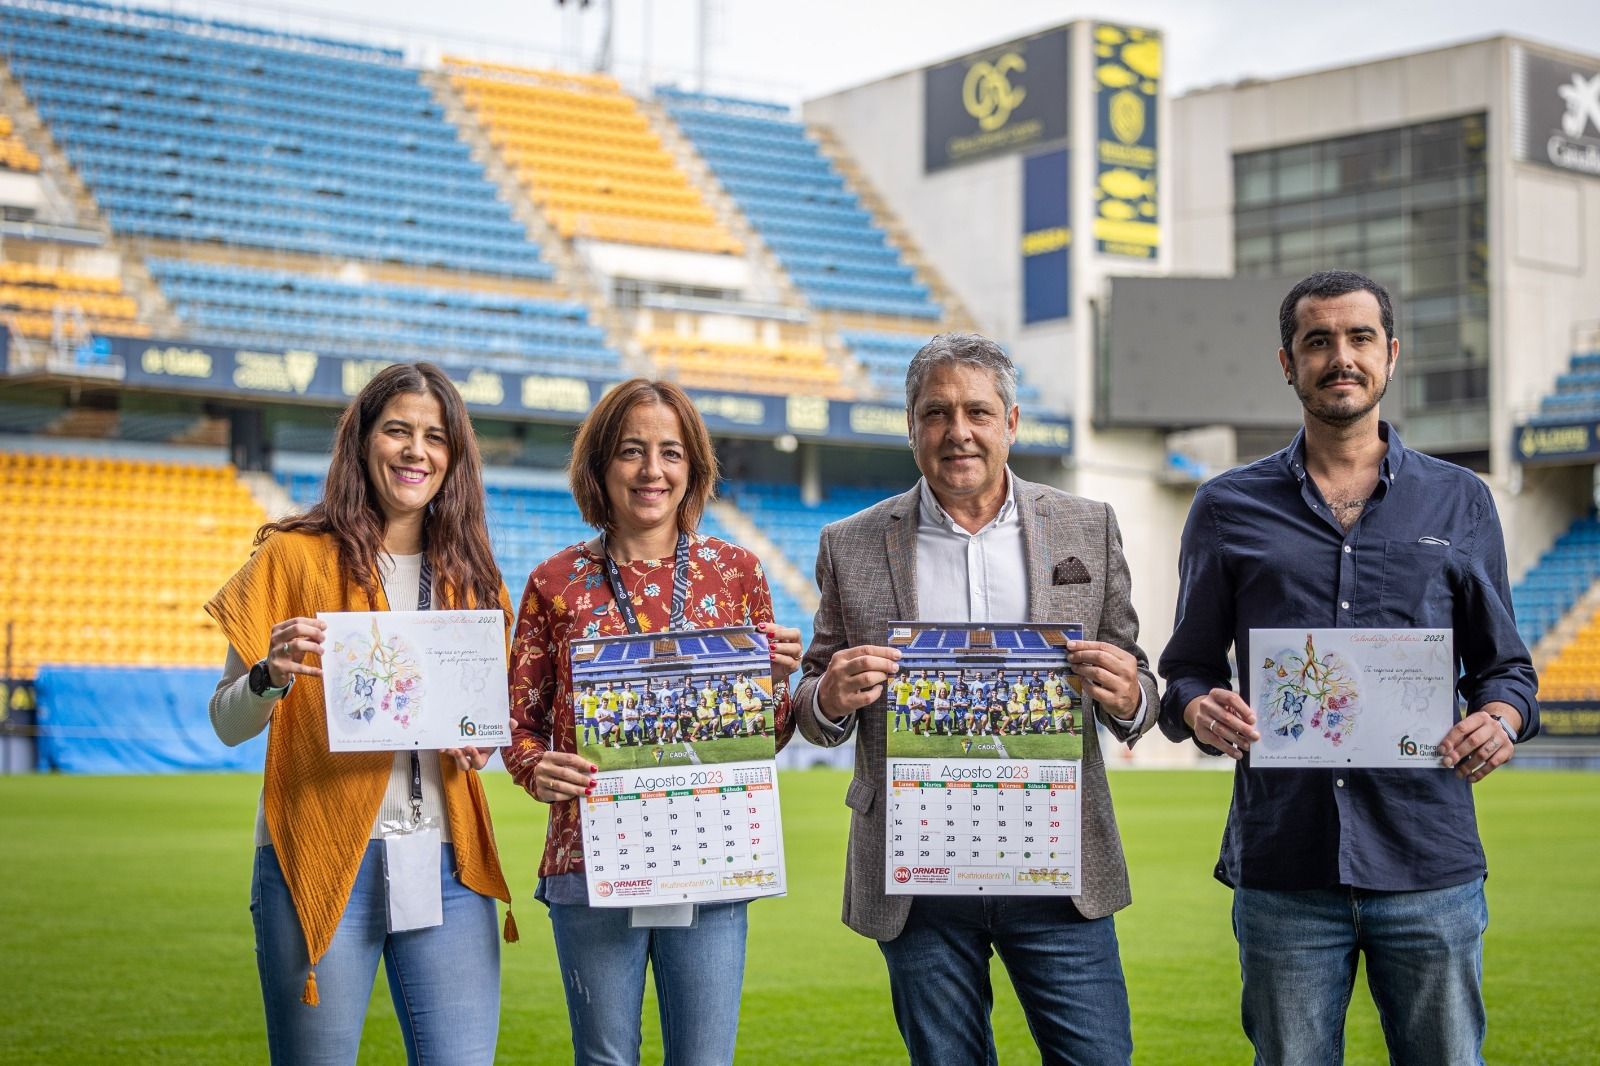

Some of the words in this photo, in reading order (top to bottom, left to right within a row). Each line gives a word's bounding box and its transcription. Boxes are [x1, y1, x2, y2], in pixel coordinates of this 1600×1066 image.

[634, 774, 686, 791] Agosto
[691, 771, 723, 785] 2023
[941, 765, 992, 781] Agosto
[996, 766, 1029, 779] 2023
[614, 880, 652, 888] ORNATEC
